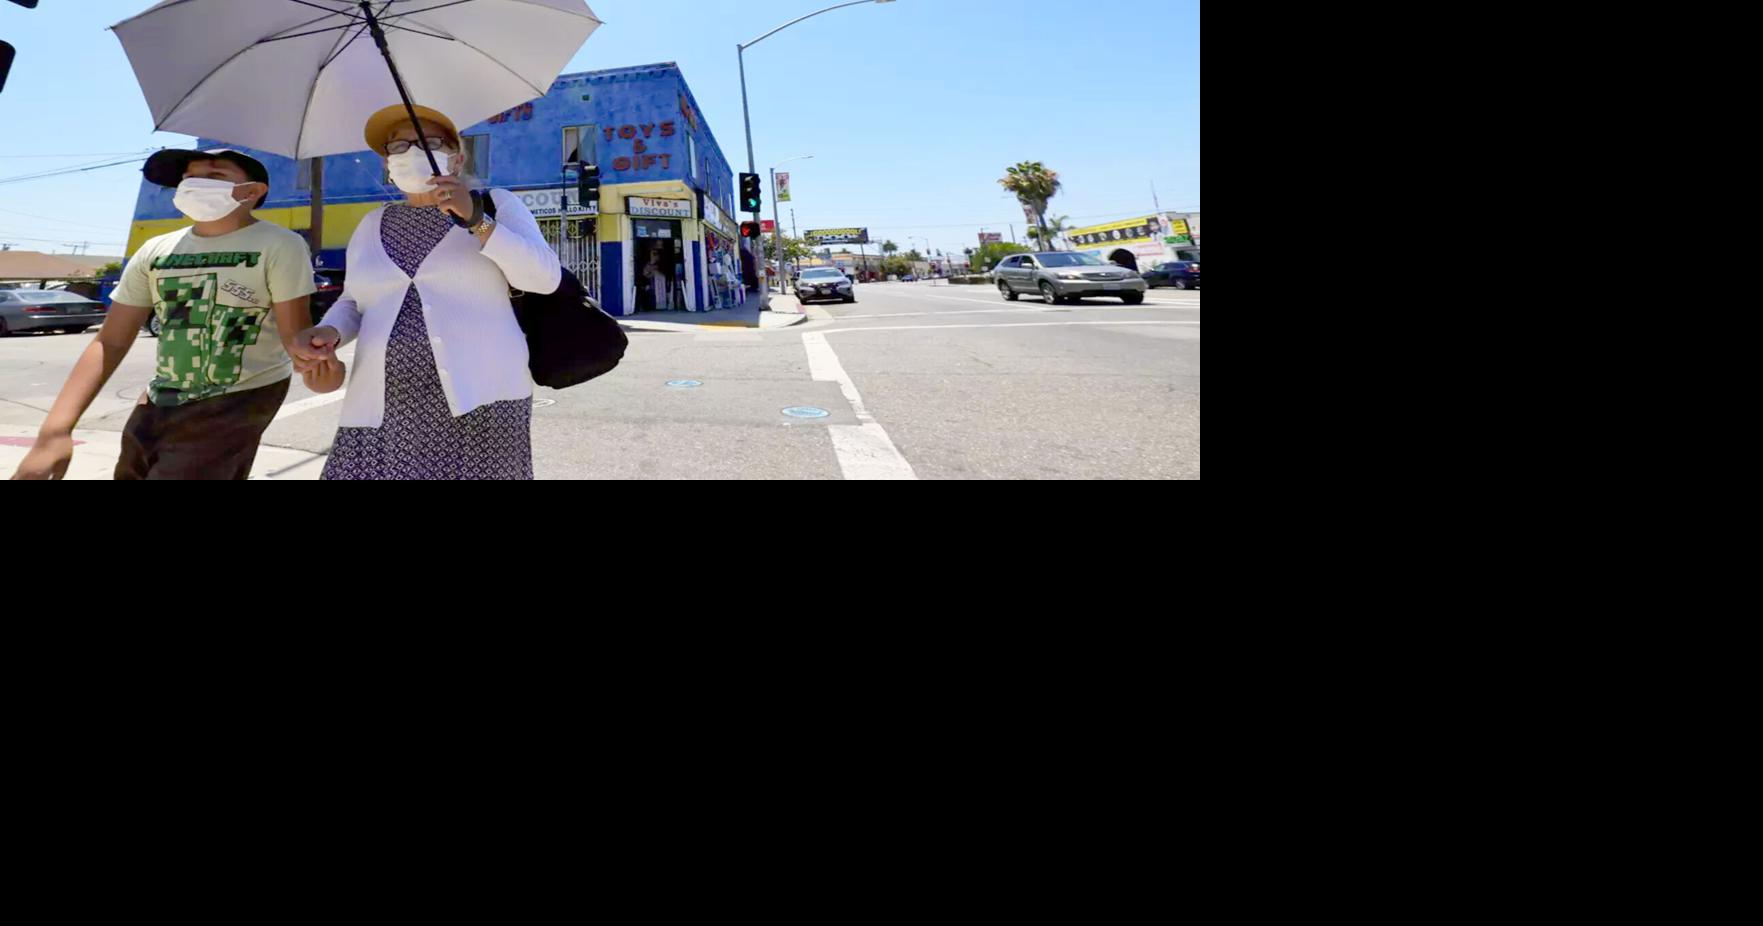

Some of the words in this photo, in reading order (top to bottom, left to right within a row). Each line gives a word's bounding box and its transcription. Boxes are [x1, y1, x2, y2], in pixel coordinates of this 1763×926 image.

[603, 121, 676, 142] TOYS
[612, 153, 672, 172] GIFT
[631, 206, 690, 217] DISCOUNT
